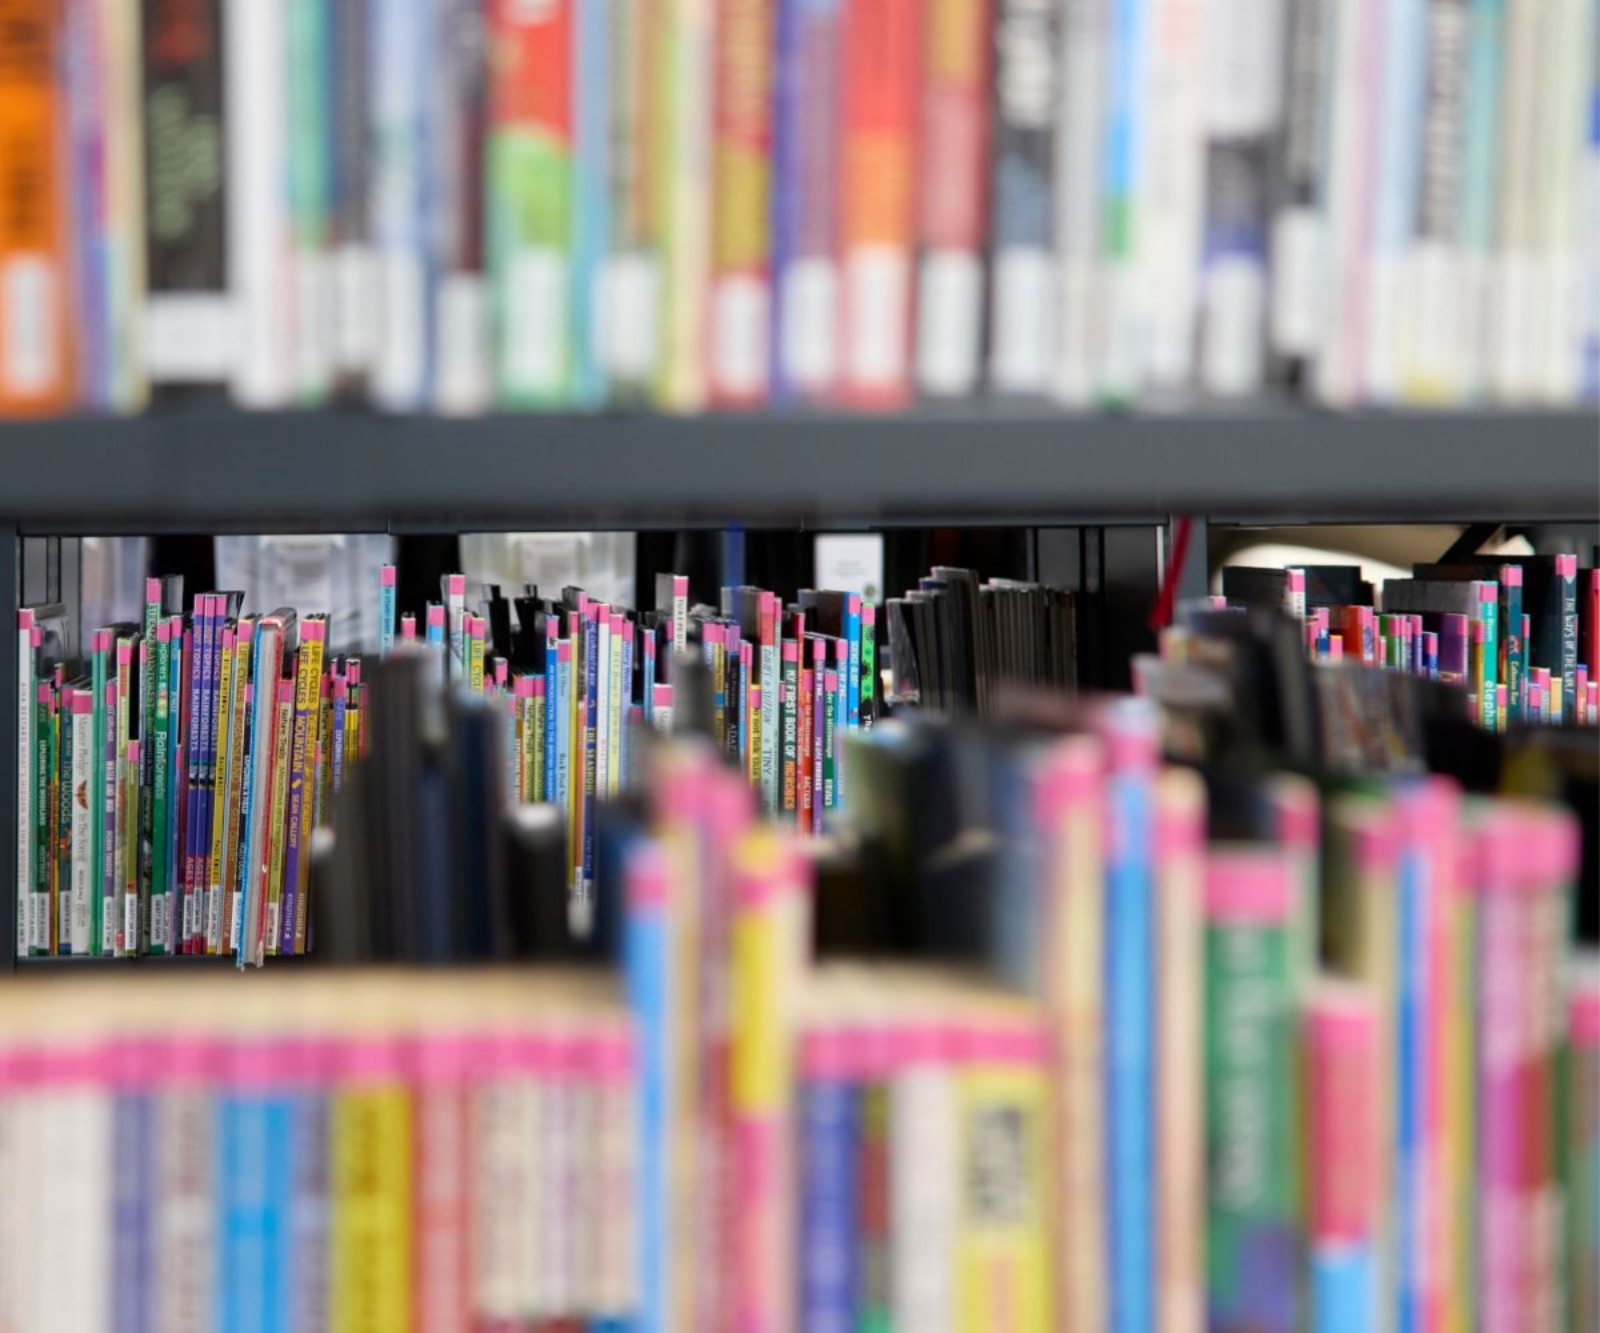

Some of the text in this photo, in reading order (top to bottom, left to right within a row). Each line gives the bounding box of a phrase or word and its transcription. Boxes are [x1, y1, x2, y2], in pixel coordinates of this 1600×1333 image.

[192, 648, 201, 680] TOPICS
[203, 648, 212, 680] TOPICS
[1564, 597, 1576, 694] THE WAYS OF THE WOLF
[236, 667, 246, 702] CYCLES
[298, 668, 306, 704] CYCLES
[1511, 660, 1519, 690] Catherine
[191, 688, 200, 752] RAINFORESTS
[200, 688, 210, 752] RAINFORESTS
[306, 645, 320, 758] LIFE CYCLES DESERT
[280, 708, 288, 736] Nature
[752, 717, 761, 734] not
[784, 669, 796, 809] MY FIRST BOOK OF MICROBES
[825, 718, 833, 758] Microscope
[279, 738, 288, 759] Trails
[294, 715, 304, 772] MOUNTAIN
[586, 726, 596, 797] THE SEASHORE
[752, 736, 761, 752] lick
[762, 748, 772, 775] TINY
[156, 731, 168, 800] Rainforests
[62, 781, 72, 823] Woods
